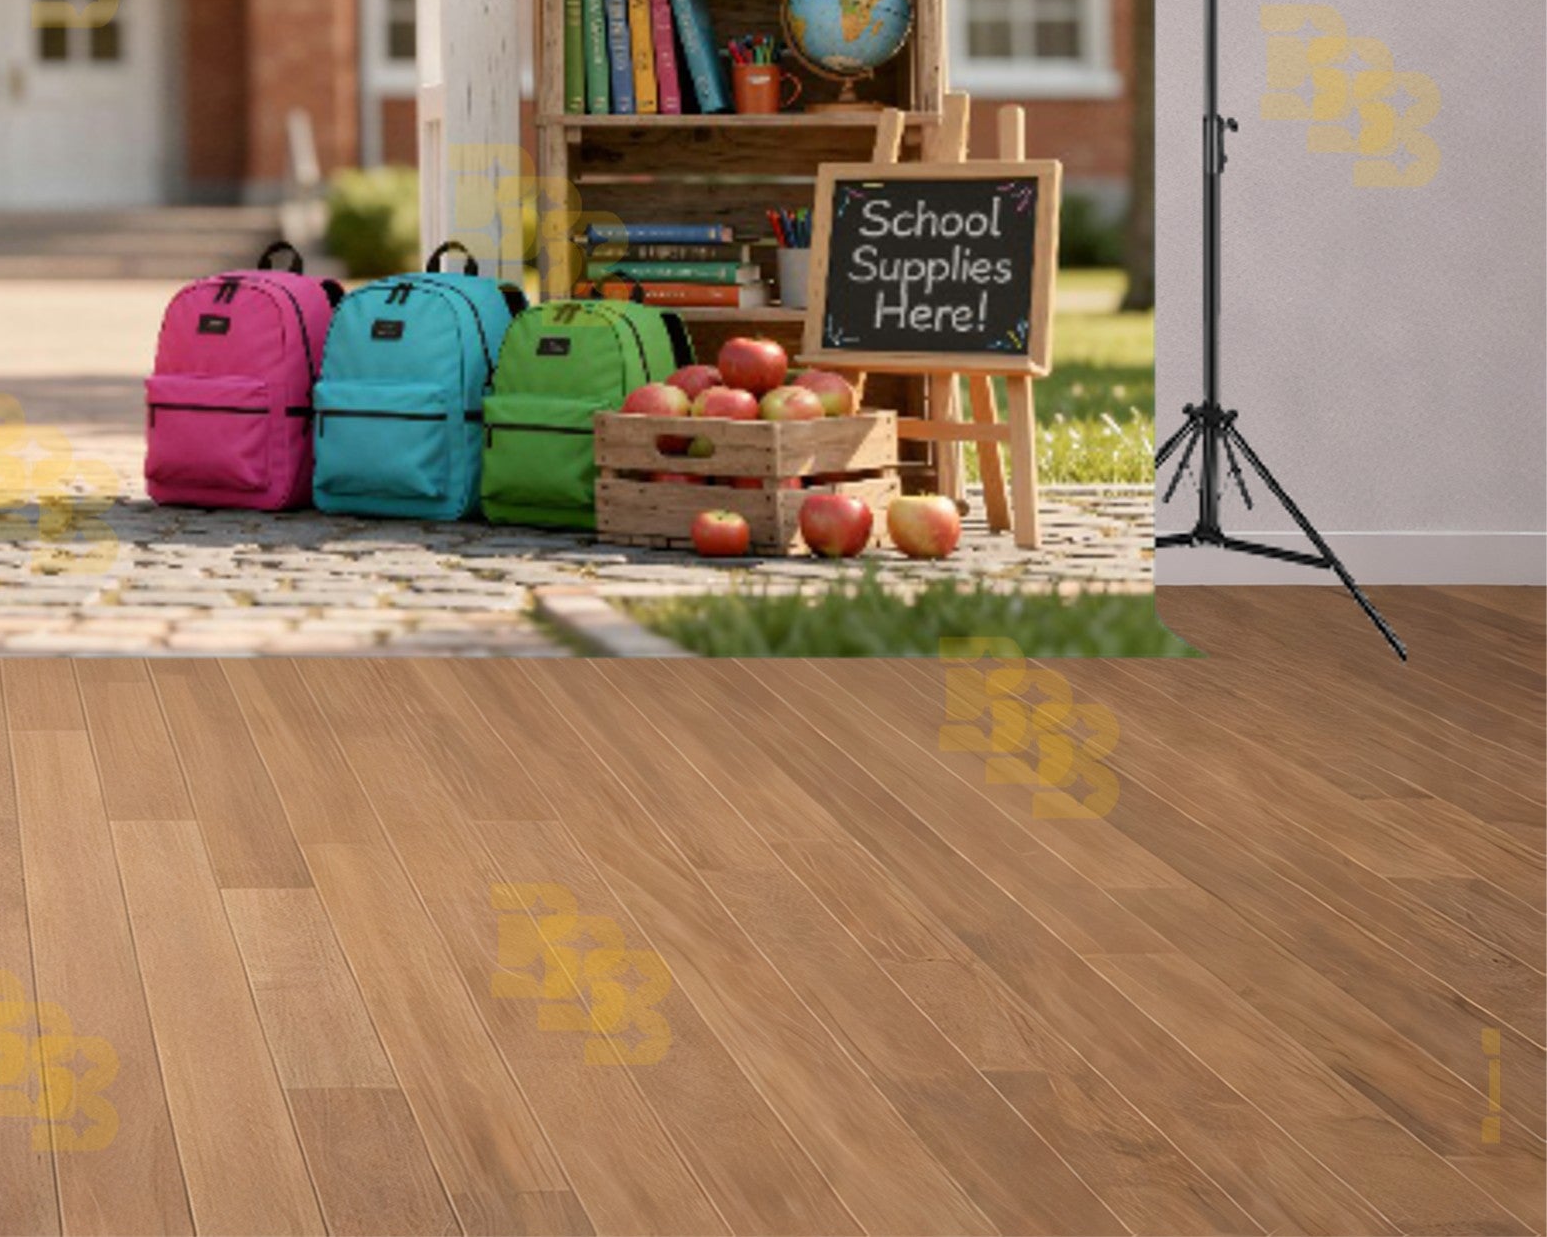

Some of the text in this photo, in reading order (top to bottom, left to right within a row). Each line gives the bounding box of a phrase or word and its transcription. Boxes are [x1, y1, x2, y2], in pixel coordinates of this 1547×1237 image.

[859, 196, 1002, 237] School
[849, 245, 1013, 295] Supplies
[873, 290, 989, 333] Here!
